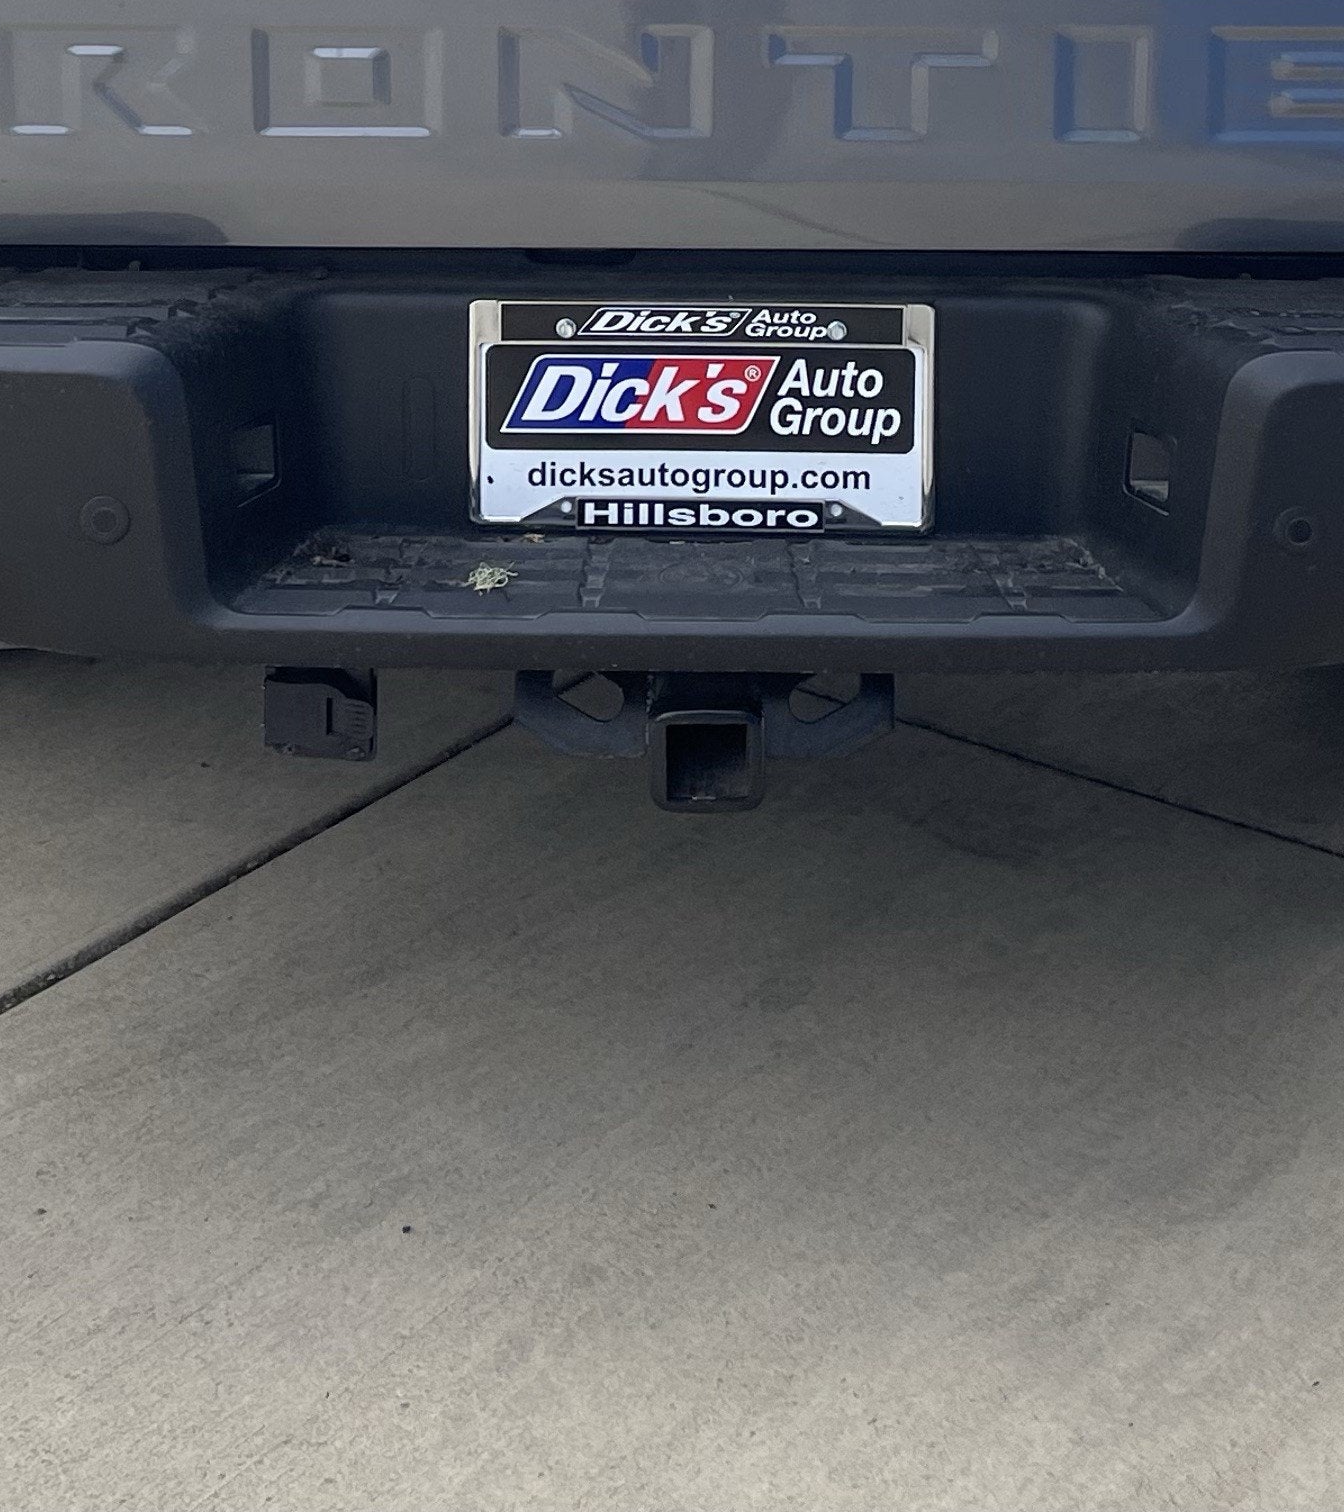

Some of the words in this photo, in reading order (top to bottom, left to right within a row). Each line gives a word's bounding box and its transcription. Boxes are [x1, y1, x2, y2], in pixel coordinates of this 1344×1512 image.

[590, 310, 732, 333] Dick's
[751, 309, 817, 324] Auto
[745, 324, 828, 341] Group
[521, 363, 750, 423] Dick's
[777, 359, 884, 399] Auto
[770, 398, 901, 444] Group
[528, 462, 871, 495] dicksautogroup.com
[584, 503, 819, 528] Hillsboro
